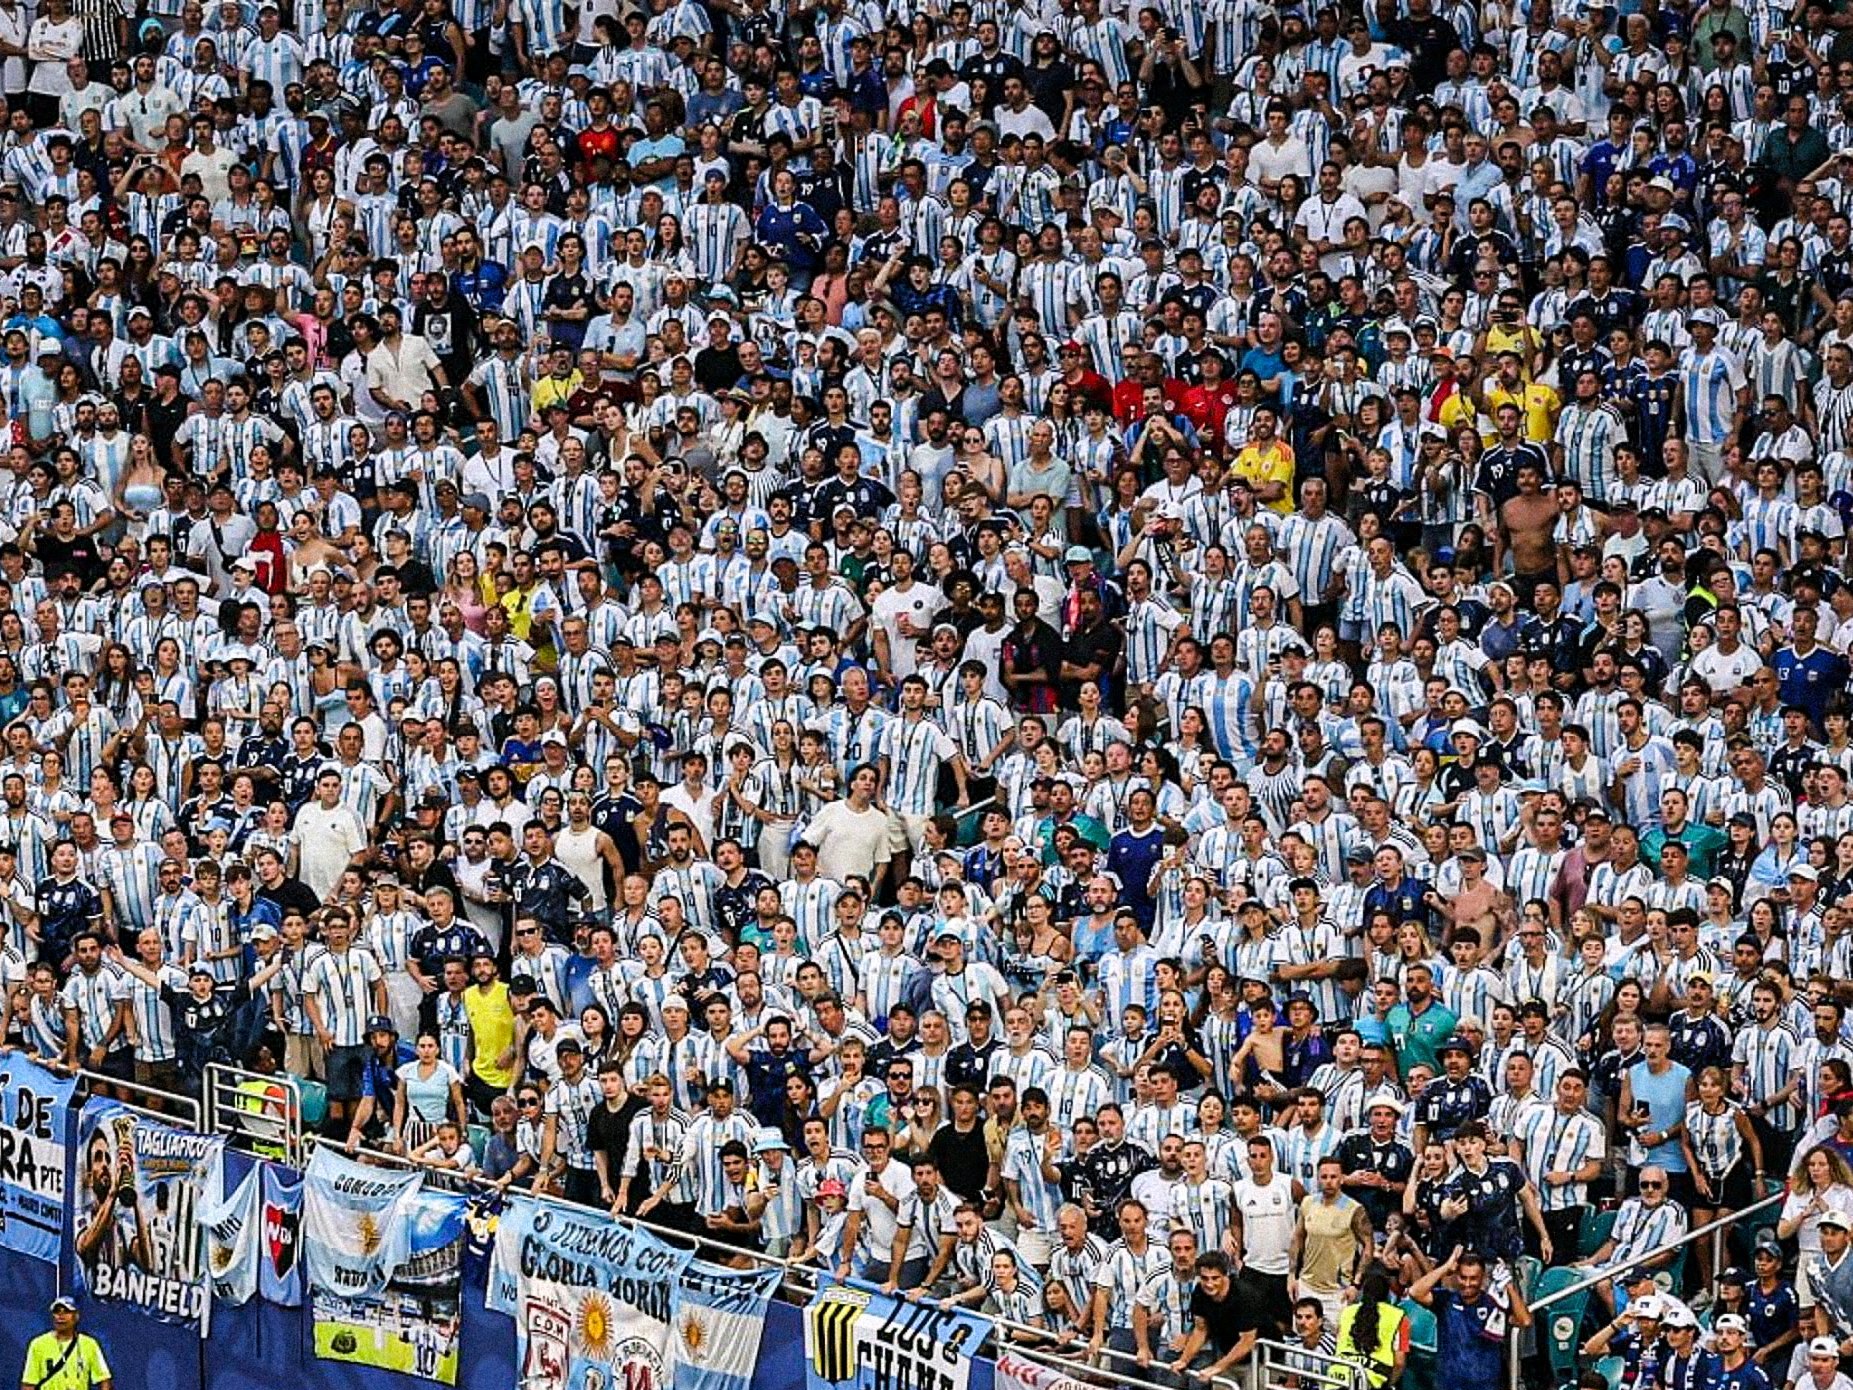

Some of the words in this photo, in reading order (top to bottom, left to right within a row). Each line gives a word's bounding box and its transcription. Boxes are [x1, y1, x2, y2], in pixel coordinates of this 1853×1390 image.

[1777, 80, 1790, 94] 10
[15, 1087, 55, 1139] DE
[40, 1165, 63, 1193] PTE
[521, 1235, 597, 1288] GLORIA
[95, 1263, 202, 1320] BANFIELD
[877, 1291, 956, 1361] LOS
